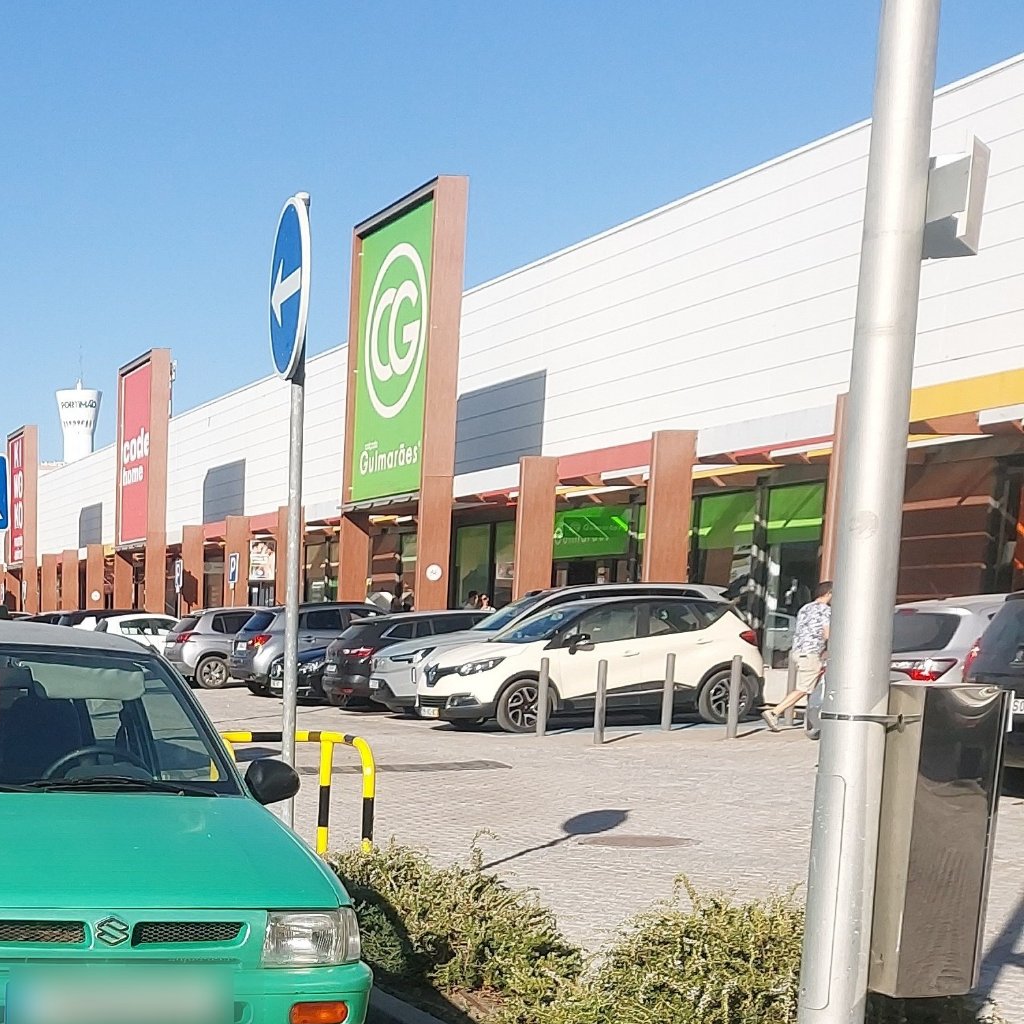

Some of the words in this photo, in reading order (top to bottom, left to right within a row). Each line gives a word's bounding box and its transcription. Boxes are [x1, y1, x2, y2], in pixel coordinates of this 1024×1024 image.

[123, 426, 149, 464] code
[360, 443, 418, 475] Guimarães
[122, 464, 144, 486] home
